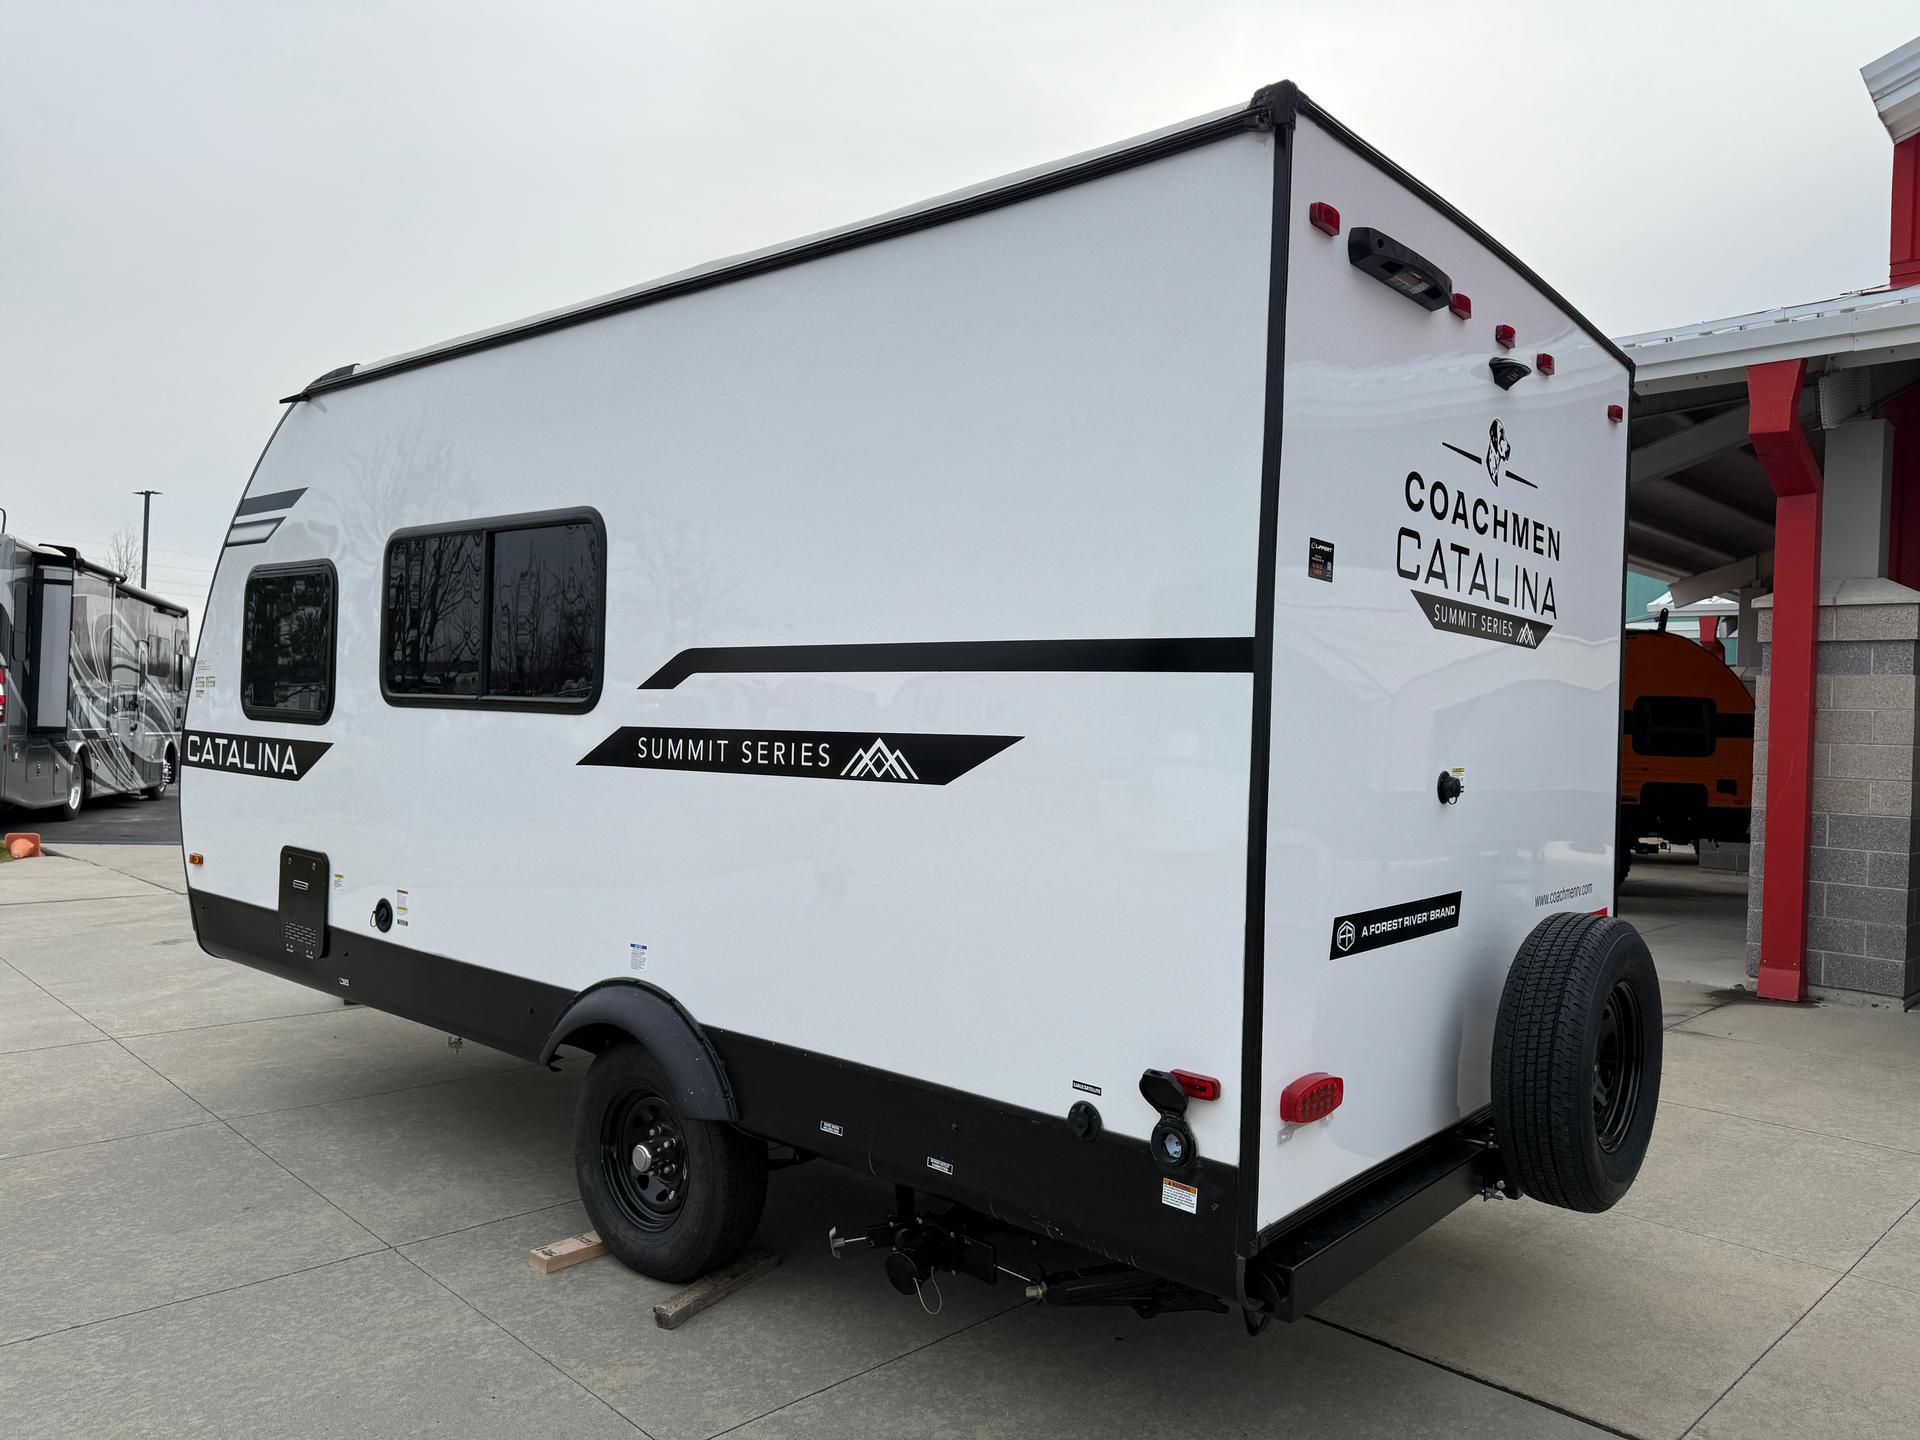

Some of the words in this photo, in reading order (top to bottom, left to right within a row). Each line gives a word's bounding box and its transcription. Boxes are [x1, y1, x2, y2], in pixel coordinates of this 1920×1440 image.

[1404, 470, 1561, 562] COACHMEN
[1396, 526, 1558, 620] CATALINA
[1433, 603, 1478, 630] SUMMIT
[1481, 614, 1514, 638] SERIES
[187, 735, 298, 775] CATALINA
[637, 736, 729, 763] SUMMIT
[741, 740, 831, 768] SERIES
[1534, 882, 1593, 908] www.coachmenrv.com
[1361, 925, 1369, 938] A
[1369, 917, 1404, 936] FOREST
[1430, 905, 1456, 921] BRAND
